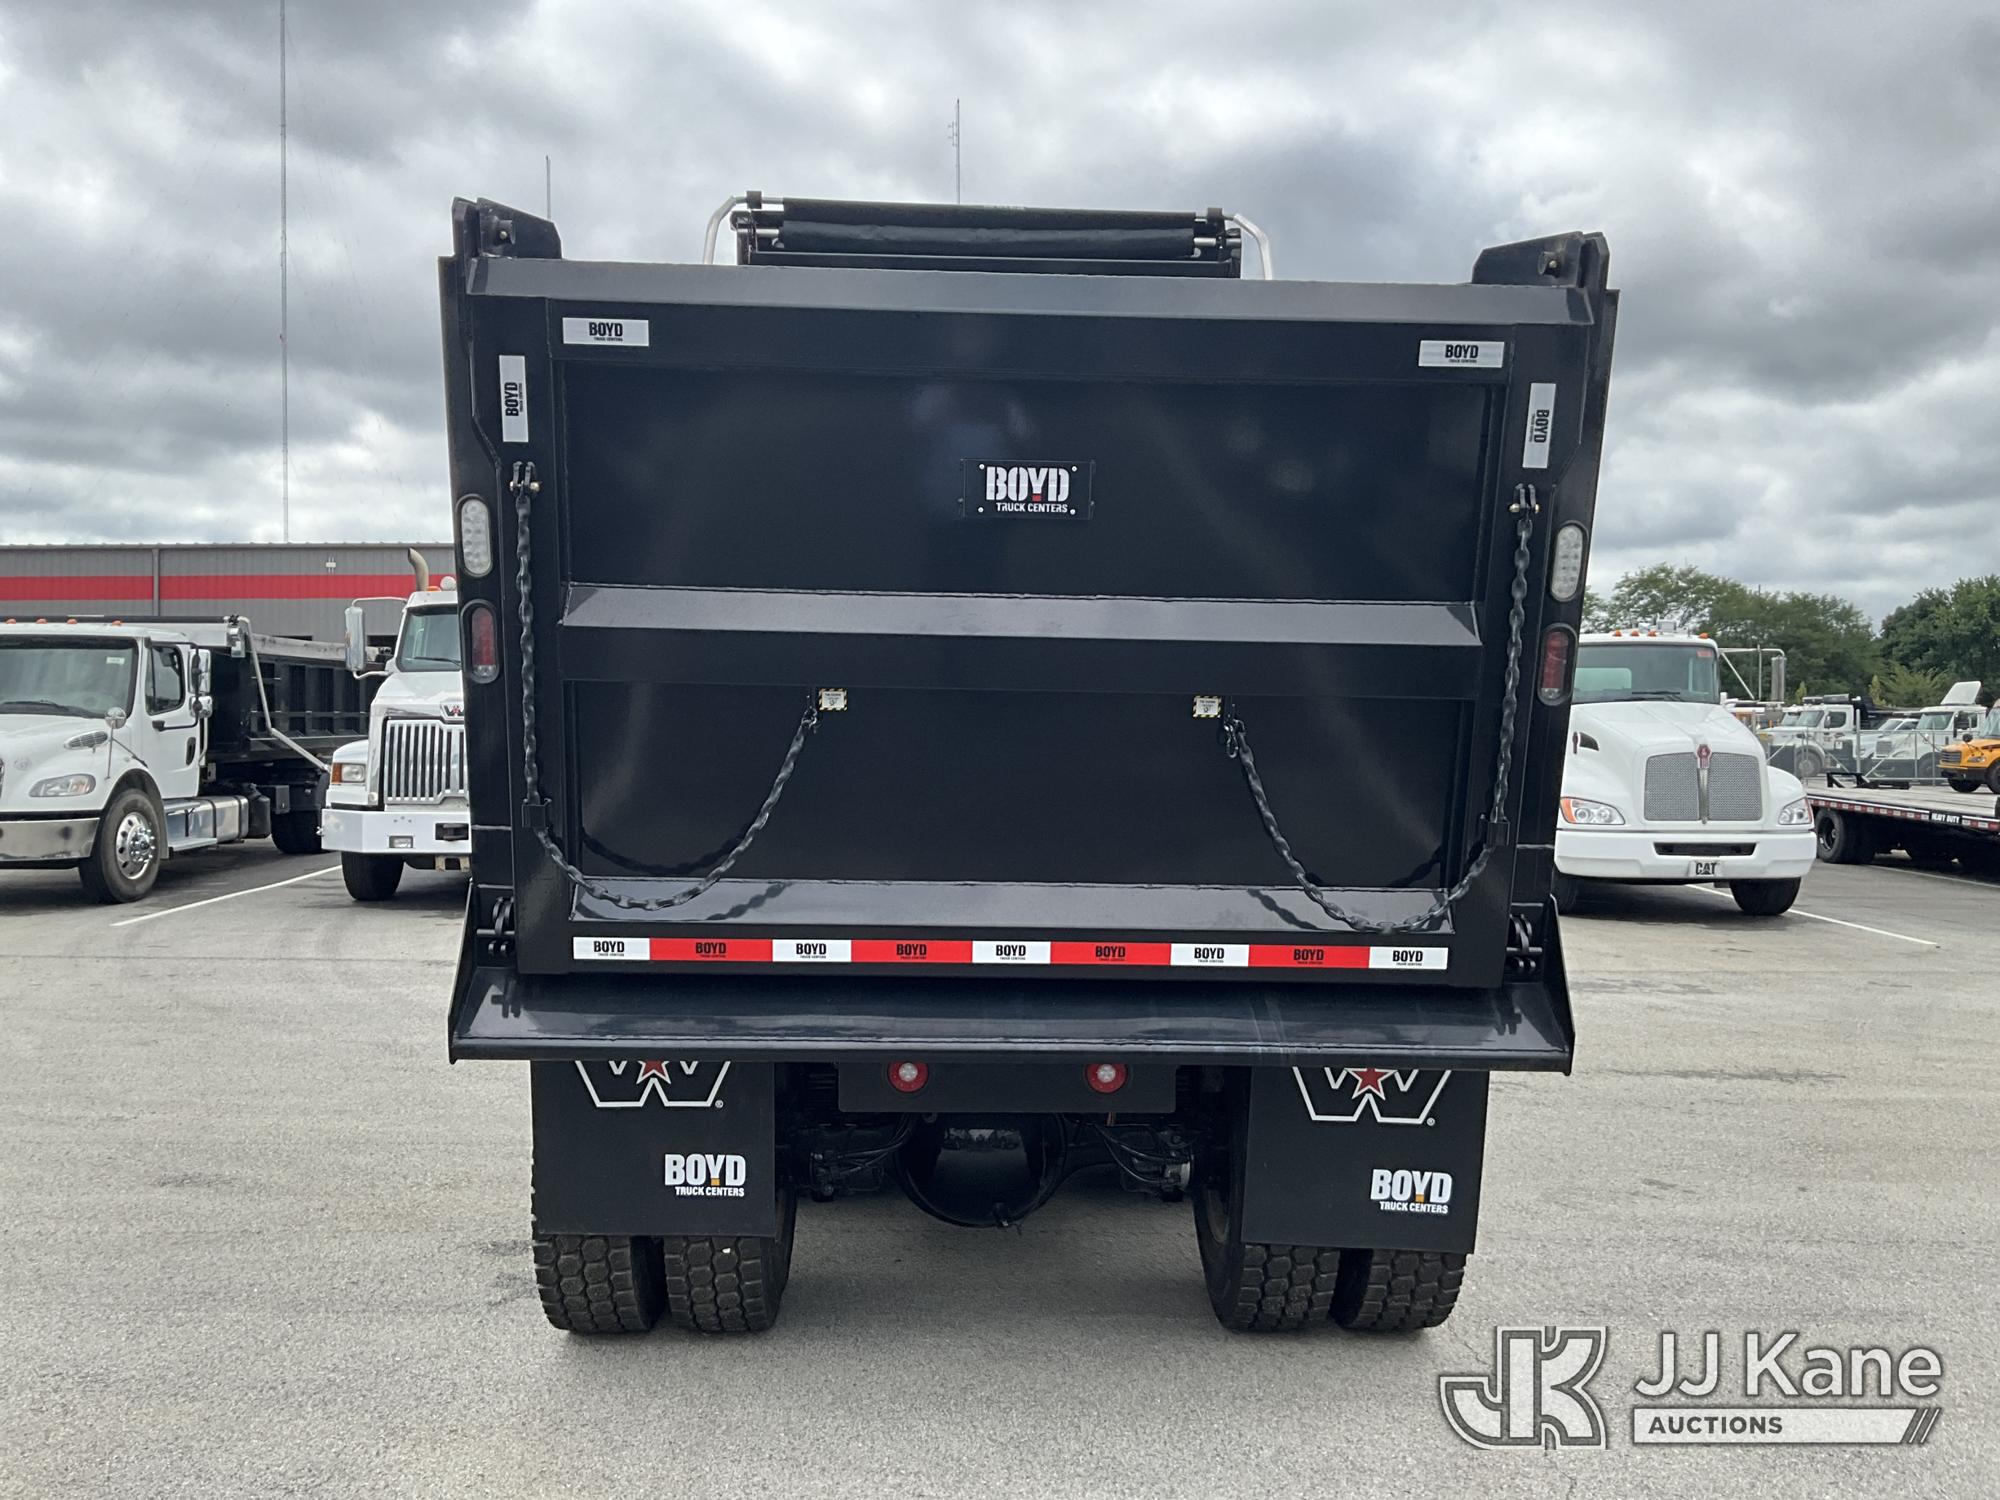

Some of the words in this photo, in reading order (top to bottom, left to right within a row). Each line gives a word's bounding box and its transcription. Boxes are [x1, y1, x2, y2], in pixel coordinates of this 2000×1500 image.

[589, 322, 623, 336] BOYD
[1445, 344, 1479, 358] BOYD
[504, 382, 519, 416] BOYD
[1534, 409, 1549, 443] BOYD
[986, 466, 1070, 502] BOYD
[996, 502, 1026, 512] TRUCK
[1027, 502, 1068, 513] CENTERS
[1696, 862, 1717, 875] CAT
[593, 941, 625, 953] BOYD
[695, 942, 727, 954] BOYD
[796, 943, 827, 955] BOYD
[896, 944, 927, 955] BOYD
[996, 945, 1026, 956] BOYD
[1095, 946, 1126, 958] BOYD
[1194, 947, 1225, 959] BOYD
[1293, 949, 1324, 960] BOYD
[1393, 950, 1423, 962] BOYD
[665, 1154, 746, 1186] BOYD
[675, 1186, 704, 1196] TRUCK
[706, 1186, 745, 1197] CENTERS
[1370, 1169, 1452, 1204] BOYD
[1379, 1201, 1408, 1212] TRUCK
[1409, 1202, 1448, 1214] CENTERS
